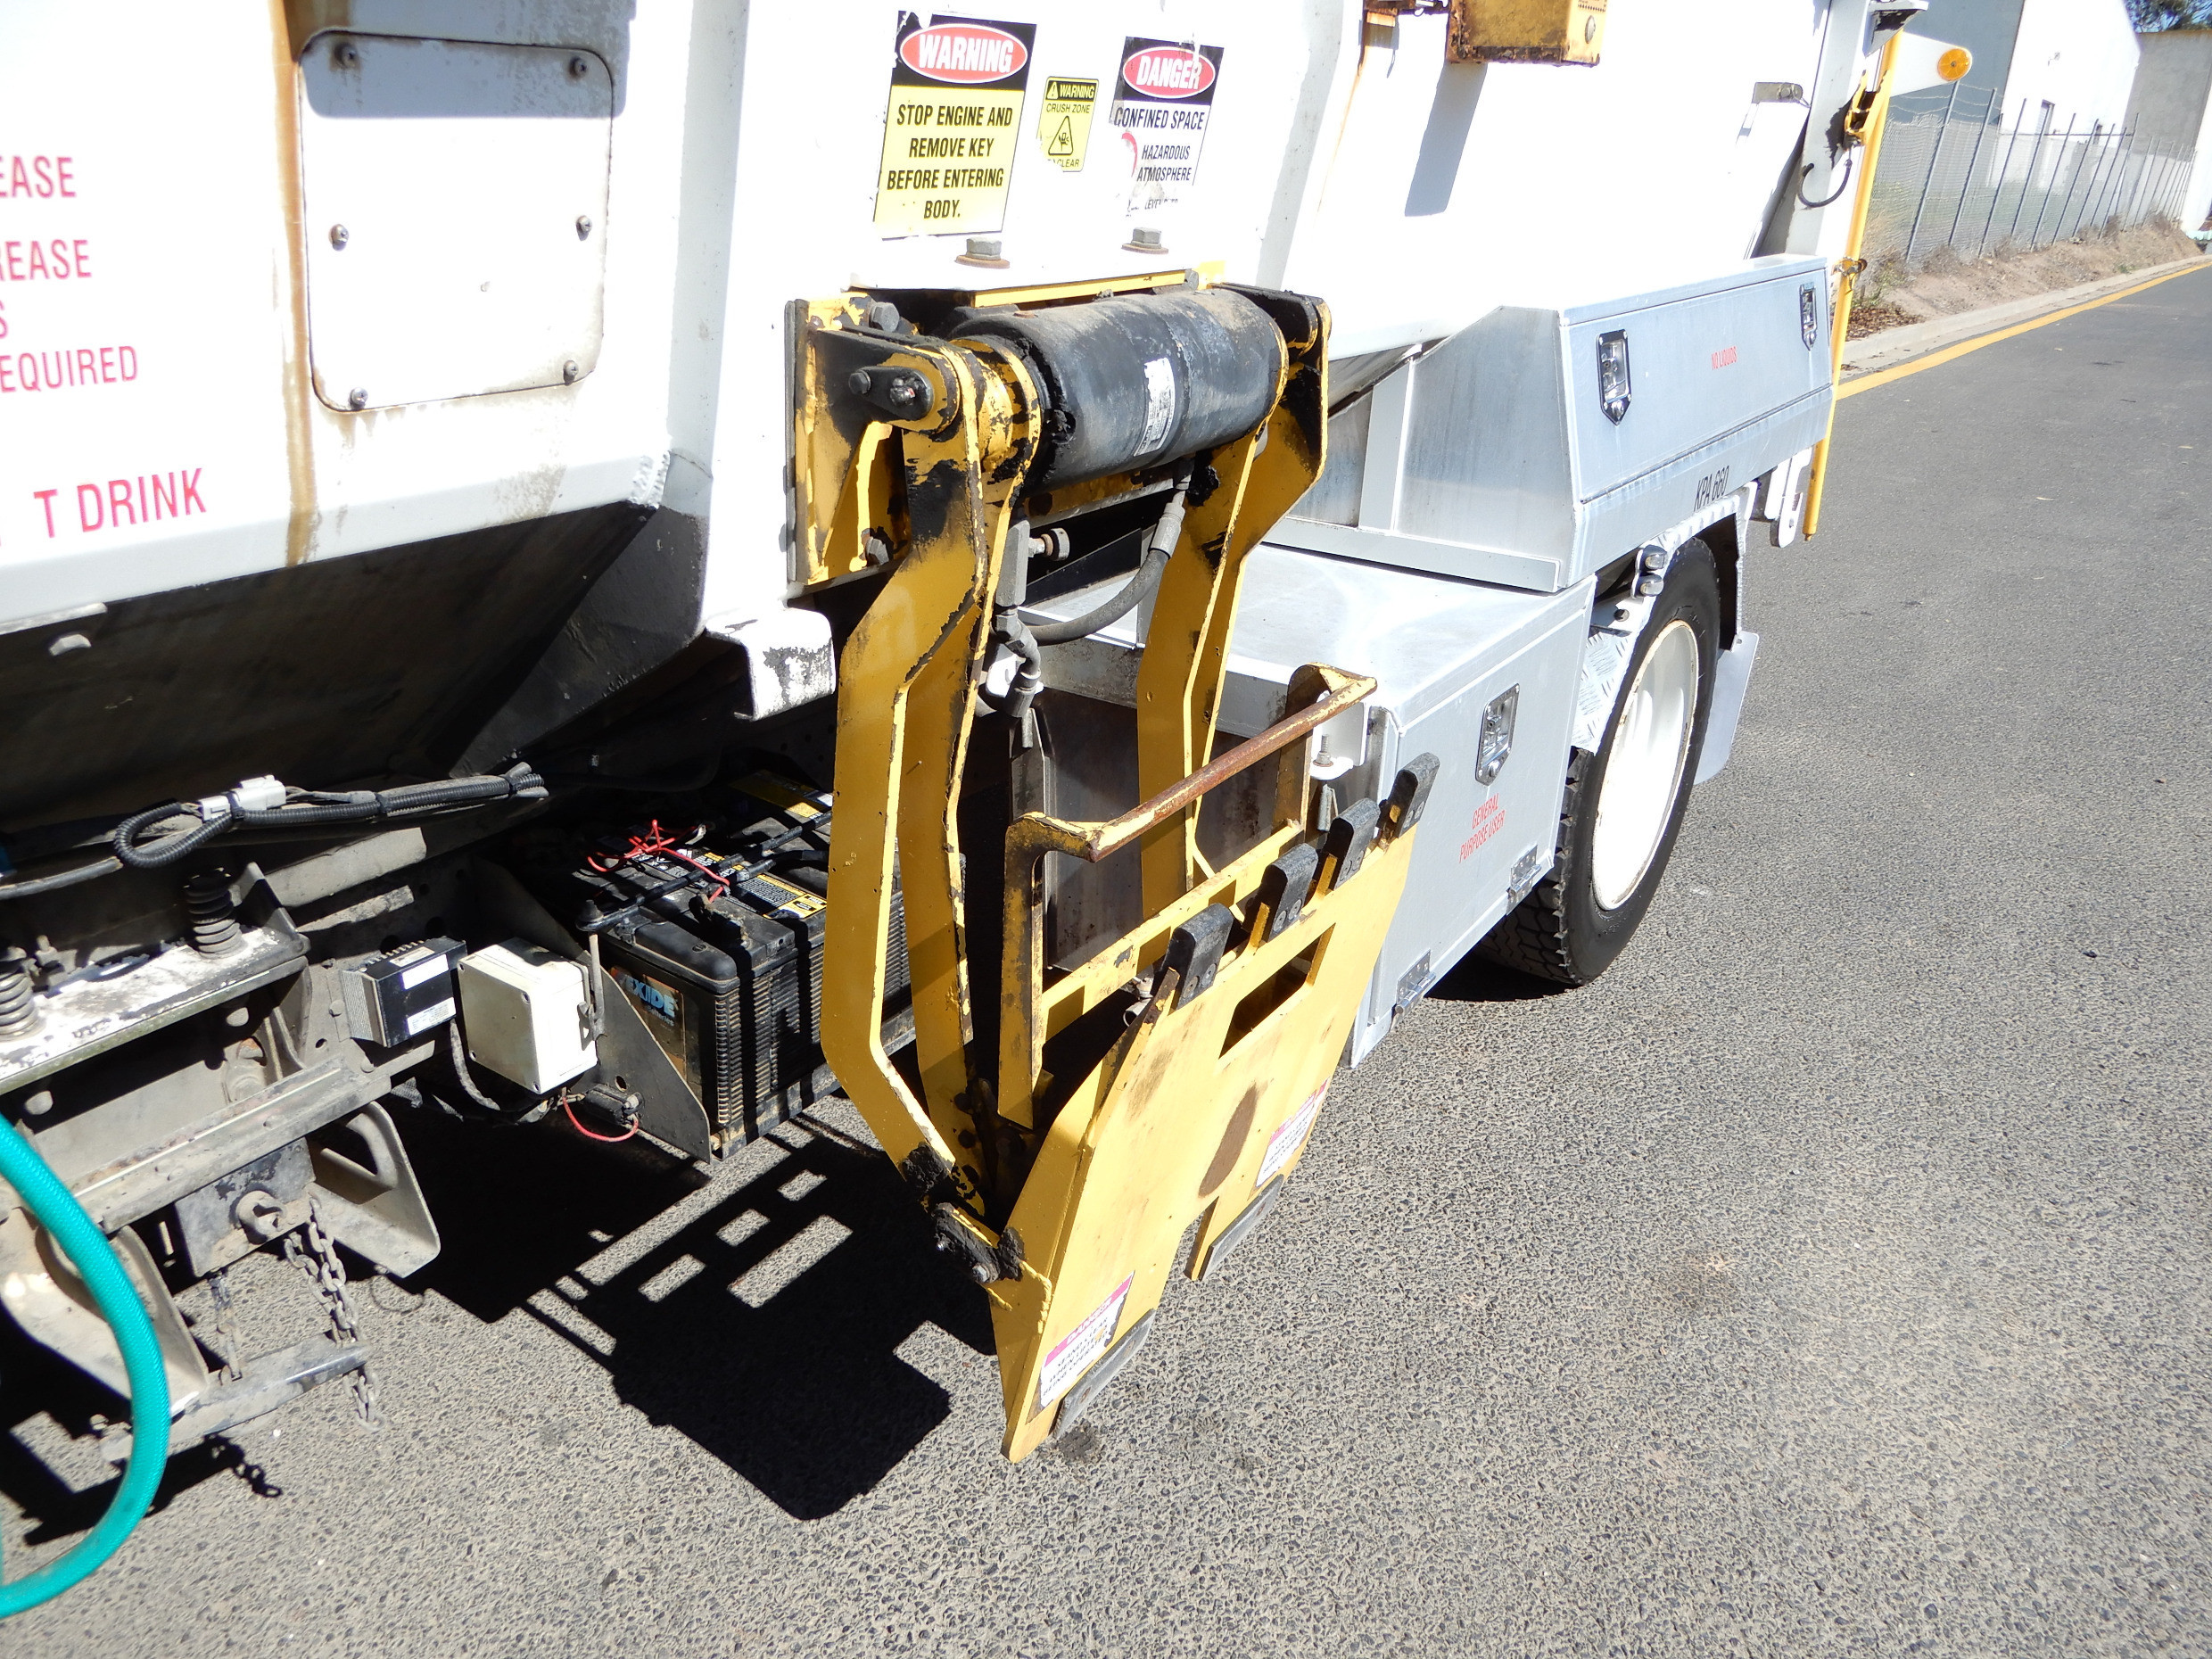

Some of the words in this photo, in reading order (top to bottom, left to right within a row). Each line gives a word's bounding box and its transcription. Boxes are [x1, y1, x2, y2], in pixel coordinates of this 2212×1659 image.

[919, 34, 1014, 73] WARNING
[1135, 55, 1202, 90] DANGER
[1060, 84, 1095, 99] WARNING
[897, 103, 933, 126] STOP
[937, 105, 985, 127] ENGINE
[986, 106, 1013, 127] AND
[1046, 103, 1070, 113] CRUSH
[1072, 103, 1091, 113] ZONE
[1113, 107, 1169, 129] CONFINED
[1170, 110, 1205, 130] SPACE
[909, 137, 966, 158] REMOVE
[968, 137, 995, 157] KEY
[1142, 144, 1191, 160] HAZARDOUS
[887, 169, 940, 190] BEFORE
[943, 168, 1004, 188] ENTERING
[1136, 167, 1193, 182] ATMOSPHERE
[924, 199, 961, 219] BODY.
[0, 239, 92, 282] EASE
[77, 467, 207, 533] DRINK
[1693, 473, 1713, 512] KPA
[1472, 792, 1499, 830] GENERAL
[1458, 822, 1489, 864] PURPOSE
[625, 974, 676, 1018] EXIDE
